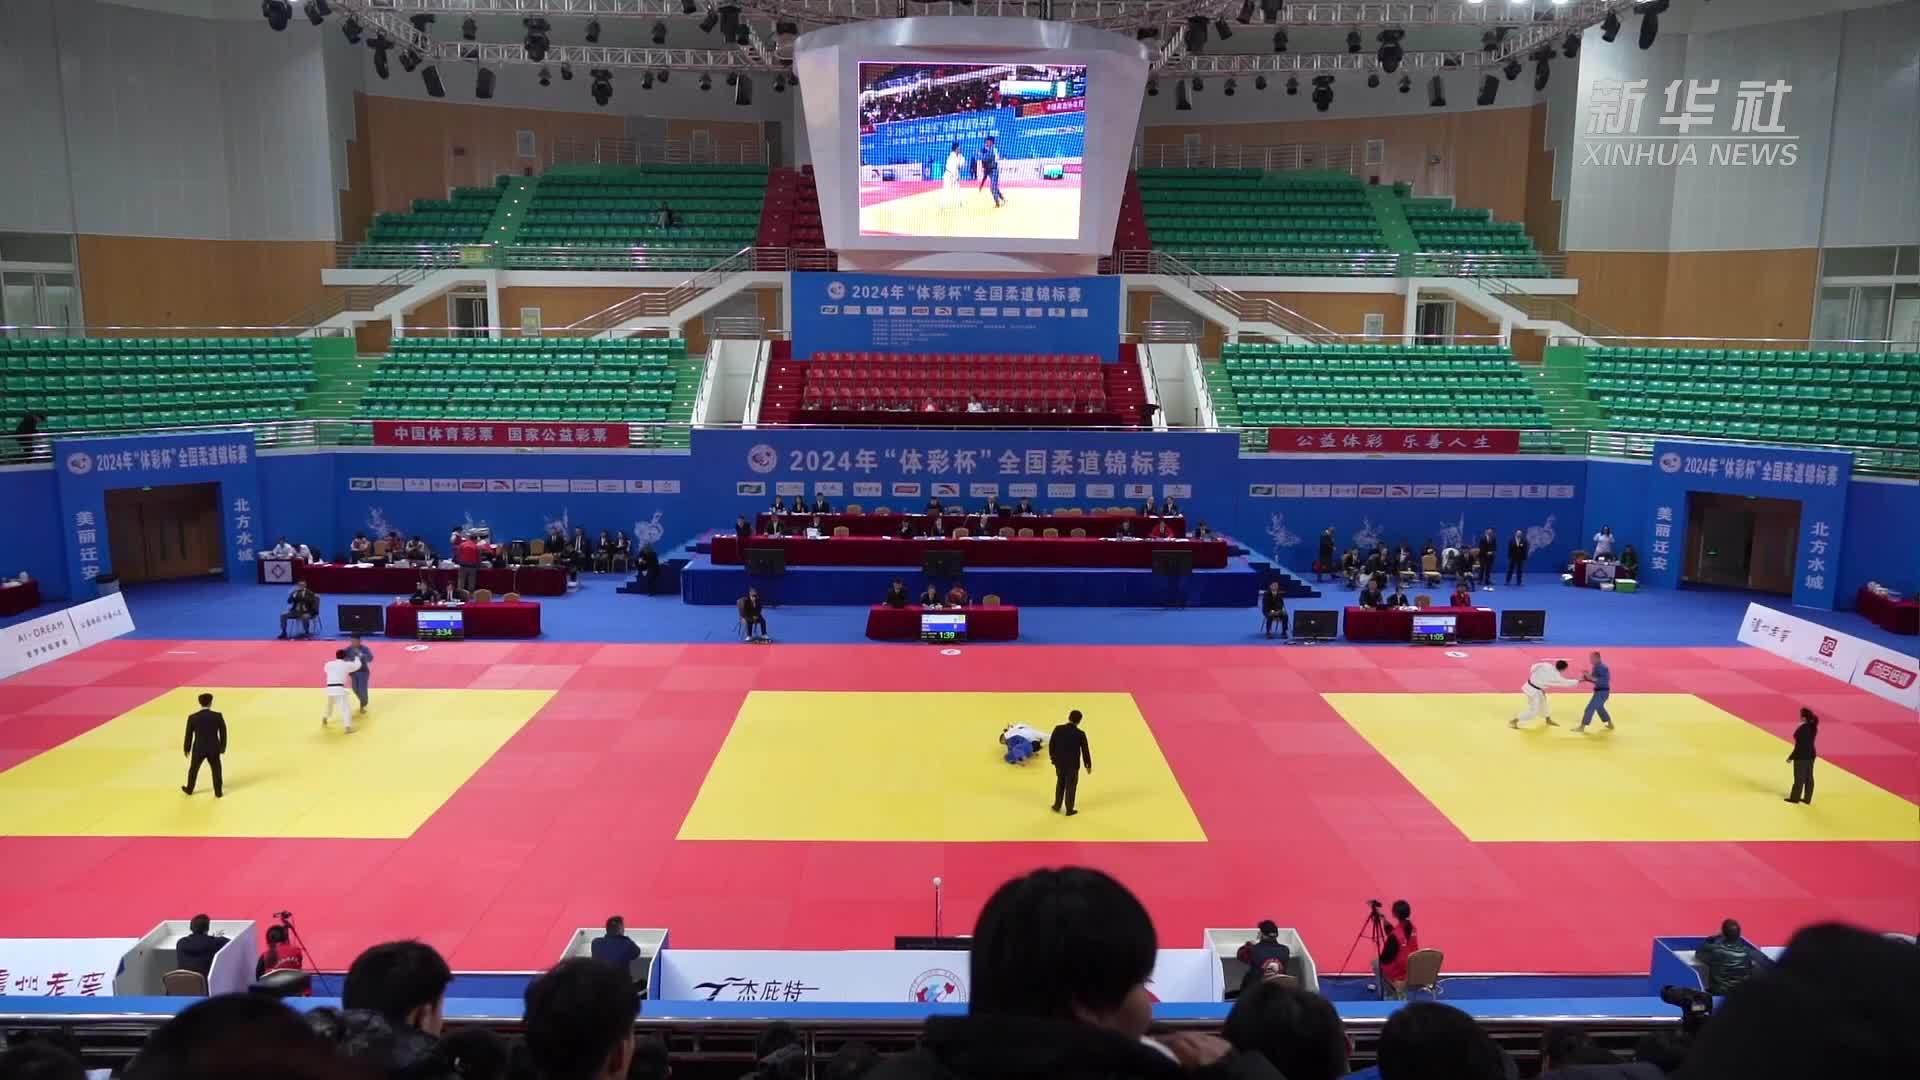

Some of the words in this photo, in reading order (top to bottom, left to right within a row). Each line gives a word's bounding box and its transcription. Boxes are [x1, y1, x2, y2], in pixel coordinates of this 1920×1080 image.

[394, 426, 494, 442] 中国体育彩票
[507, 427, 608, 442] 国家公益彩票
[1296, 432, 1384, 449] 公益体彩
[75, 511, 100, 580] 美丽迁安
[234, 498, 255, 561] 北方水城
[1651, 506, 1673, 571] 美丽迁安
[1804, 521, 1830, 590] 北方水城
